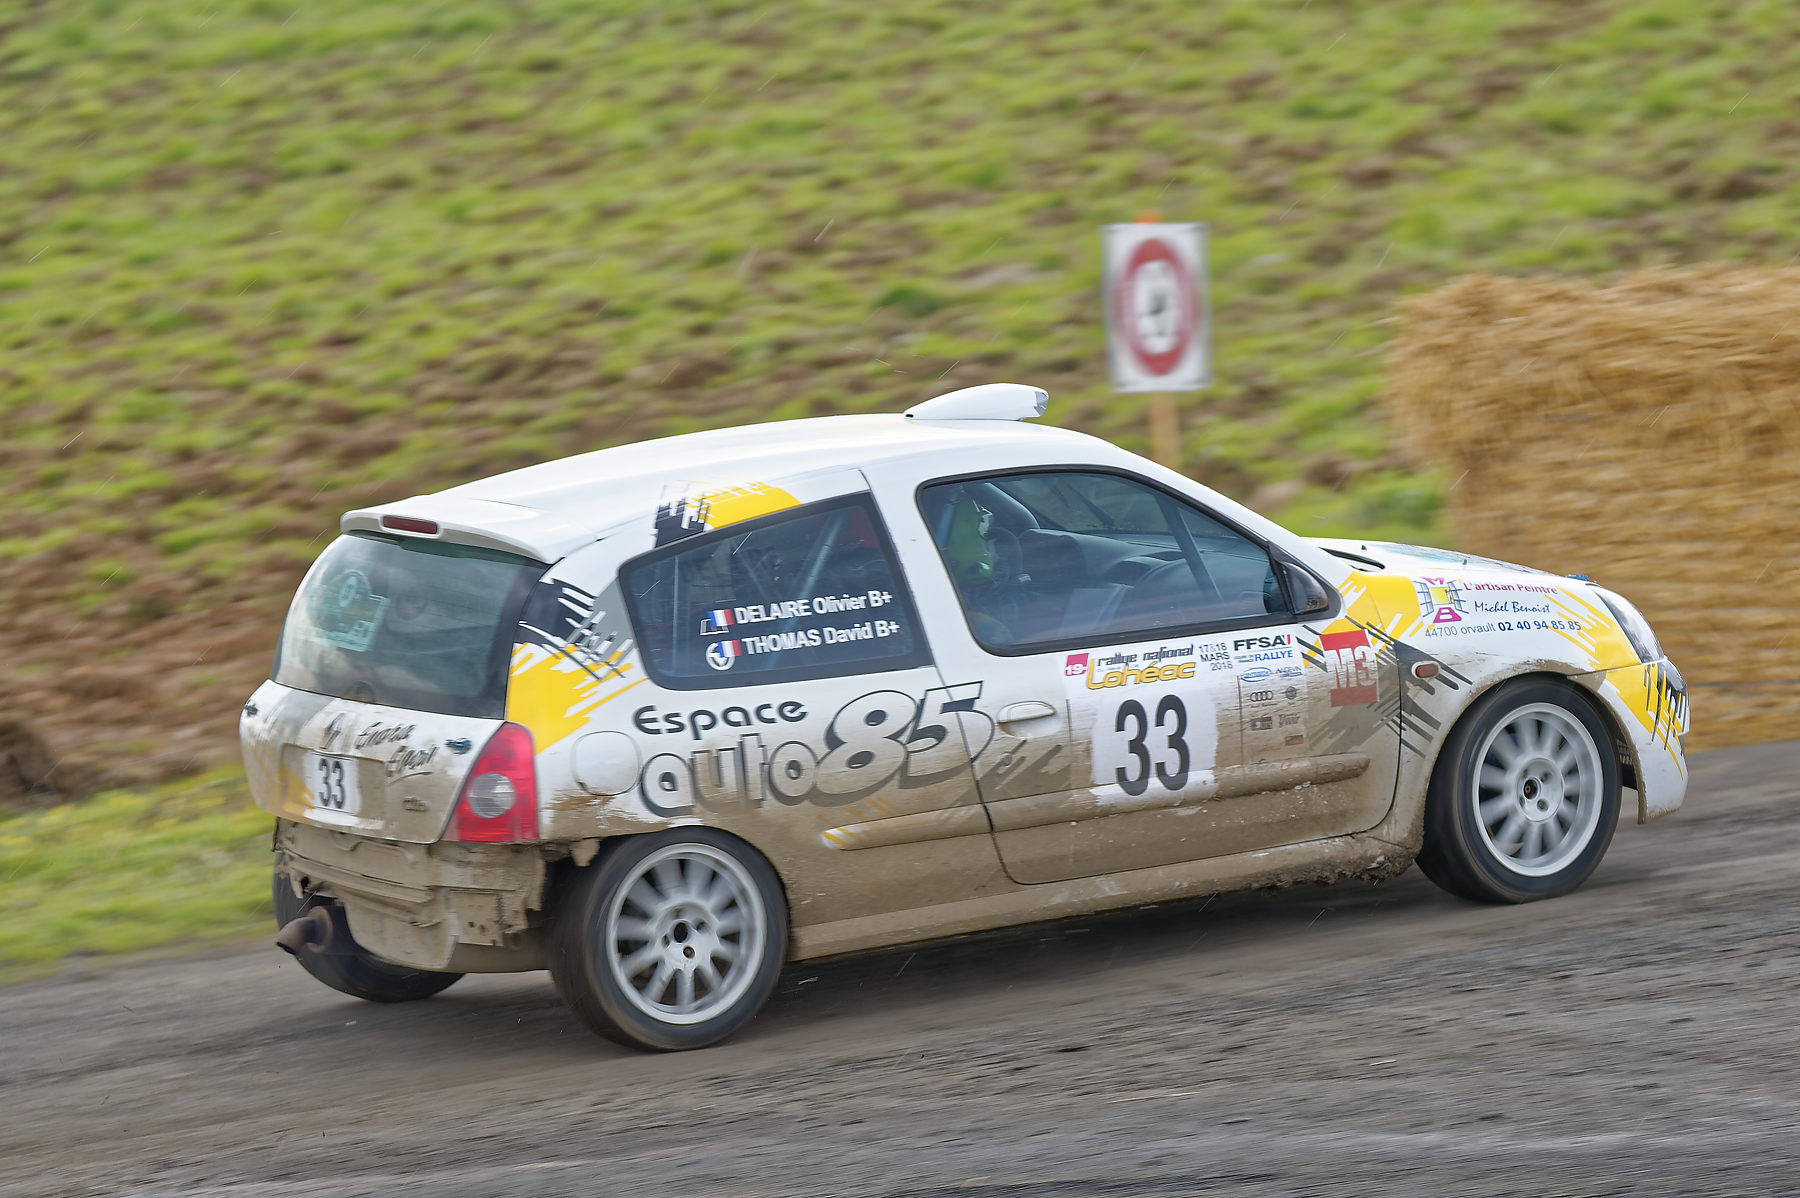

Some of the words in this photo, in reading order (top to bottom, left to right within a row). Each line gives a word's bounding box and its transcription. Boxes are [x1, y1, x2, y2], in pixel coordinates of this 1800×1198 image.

[1463, 583, 1514, 592] L'artisan
[1516, 584, 1557, 594] Peintre
[733, 600, 812, 625] DELAIRE
[812, 593, 866, 615] Olivier
[867, 590, 893, 608] B+
[1474, 601, 1509, 613] Michel
[1511, 601, 1550, 613] Benoist
[741, 629, 822, 655] THOMAS
[823, 623, 873, 645] David
[874, 619, 900, 638] B+
[1425, 626, 1458, 637] 44700
[1460, 623, 1496, 634] orvault
[1498, 622, 1513, 631] 02
[1516, 620, 1531, 630] 40
[1533, 620, 1548, 630] 94
[1550, 620, 1565, 630] 85
[1567, 620, 1582, 631] 85
[1097, 653, 1137, 666] rallye
[1143, 643, 1194, 662] national
[1234, 635, 1286, 651] FFSA
[1255, 650, 1293, 662] RALLYE
[1200, 652, 1230, 662] MARS
[1324, 645, 1377, 688] M3
[1087, 658, 1196, 690] Lohéac
[634, 700, 808, 740] Espace
[1115, 694, 1190, 796] 33
[317, 757, 346, 810] 33
